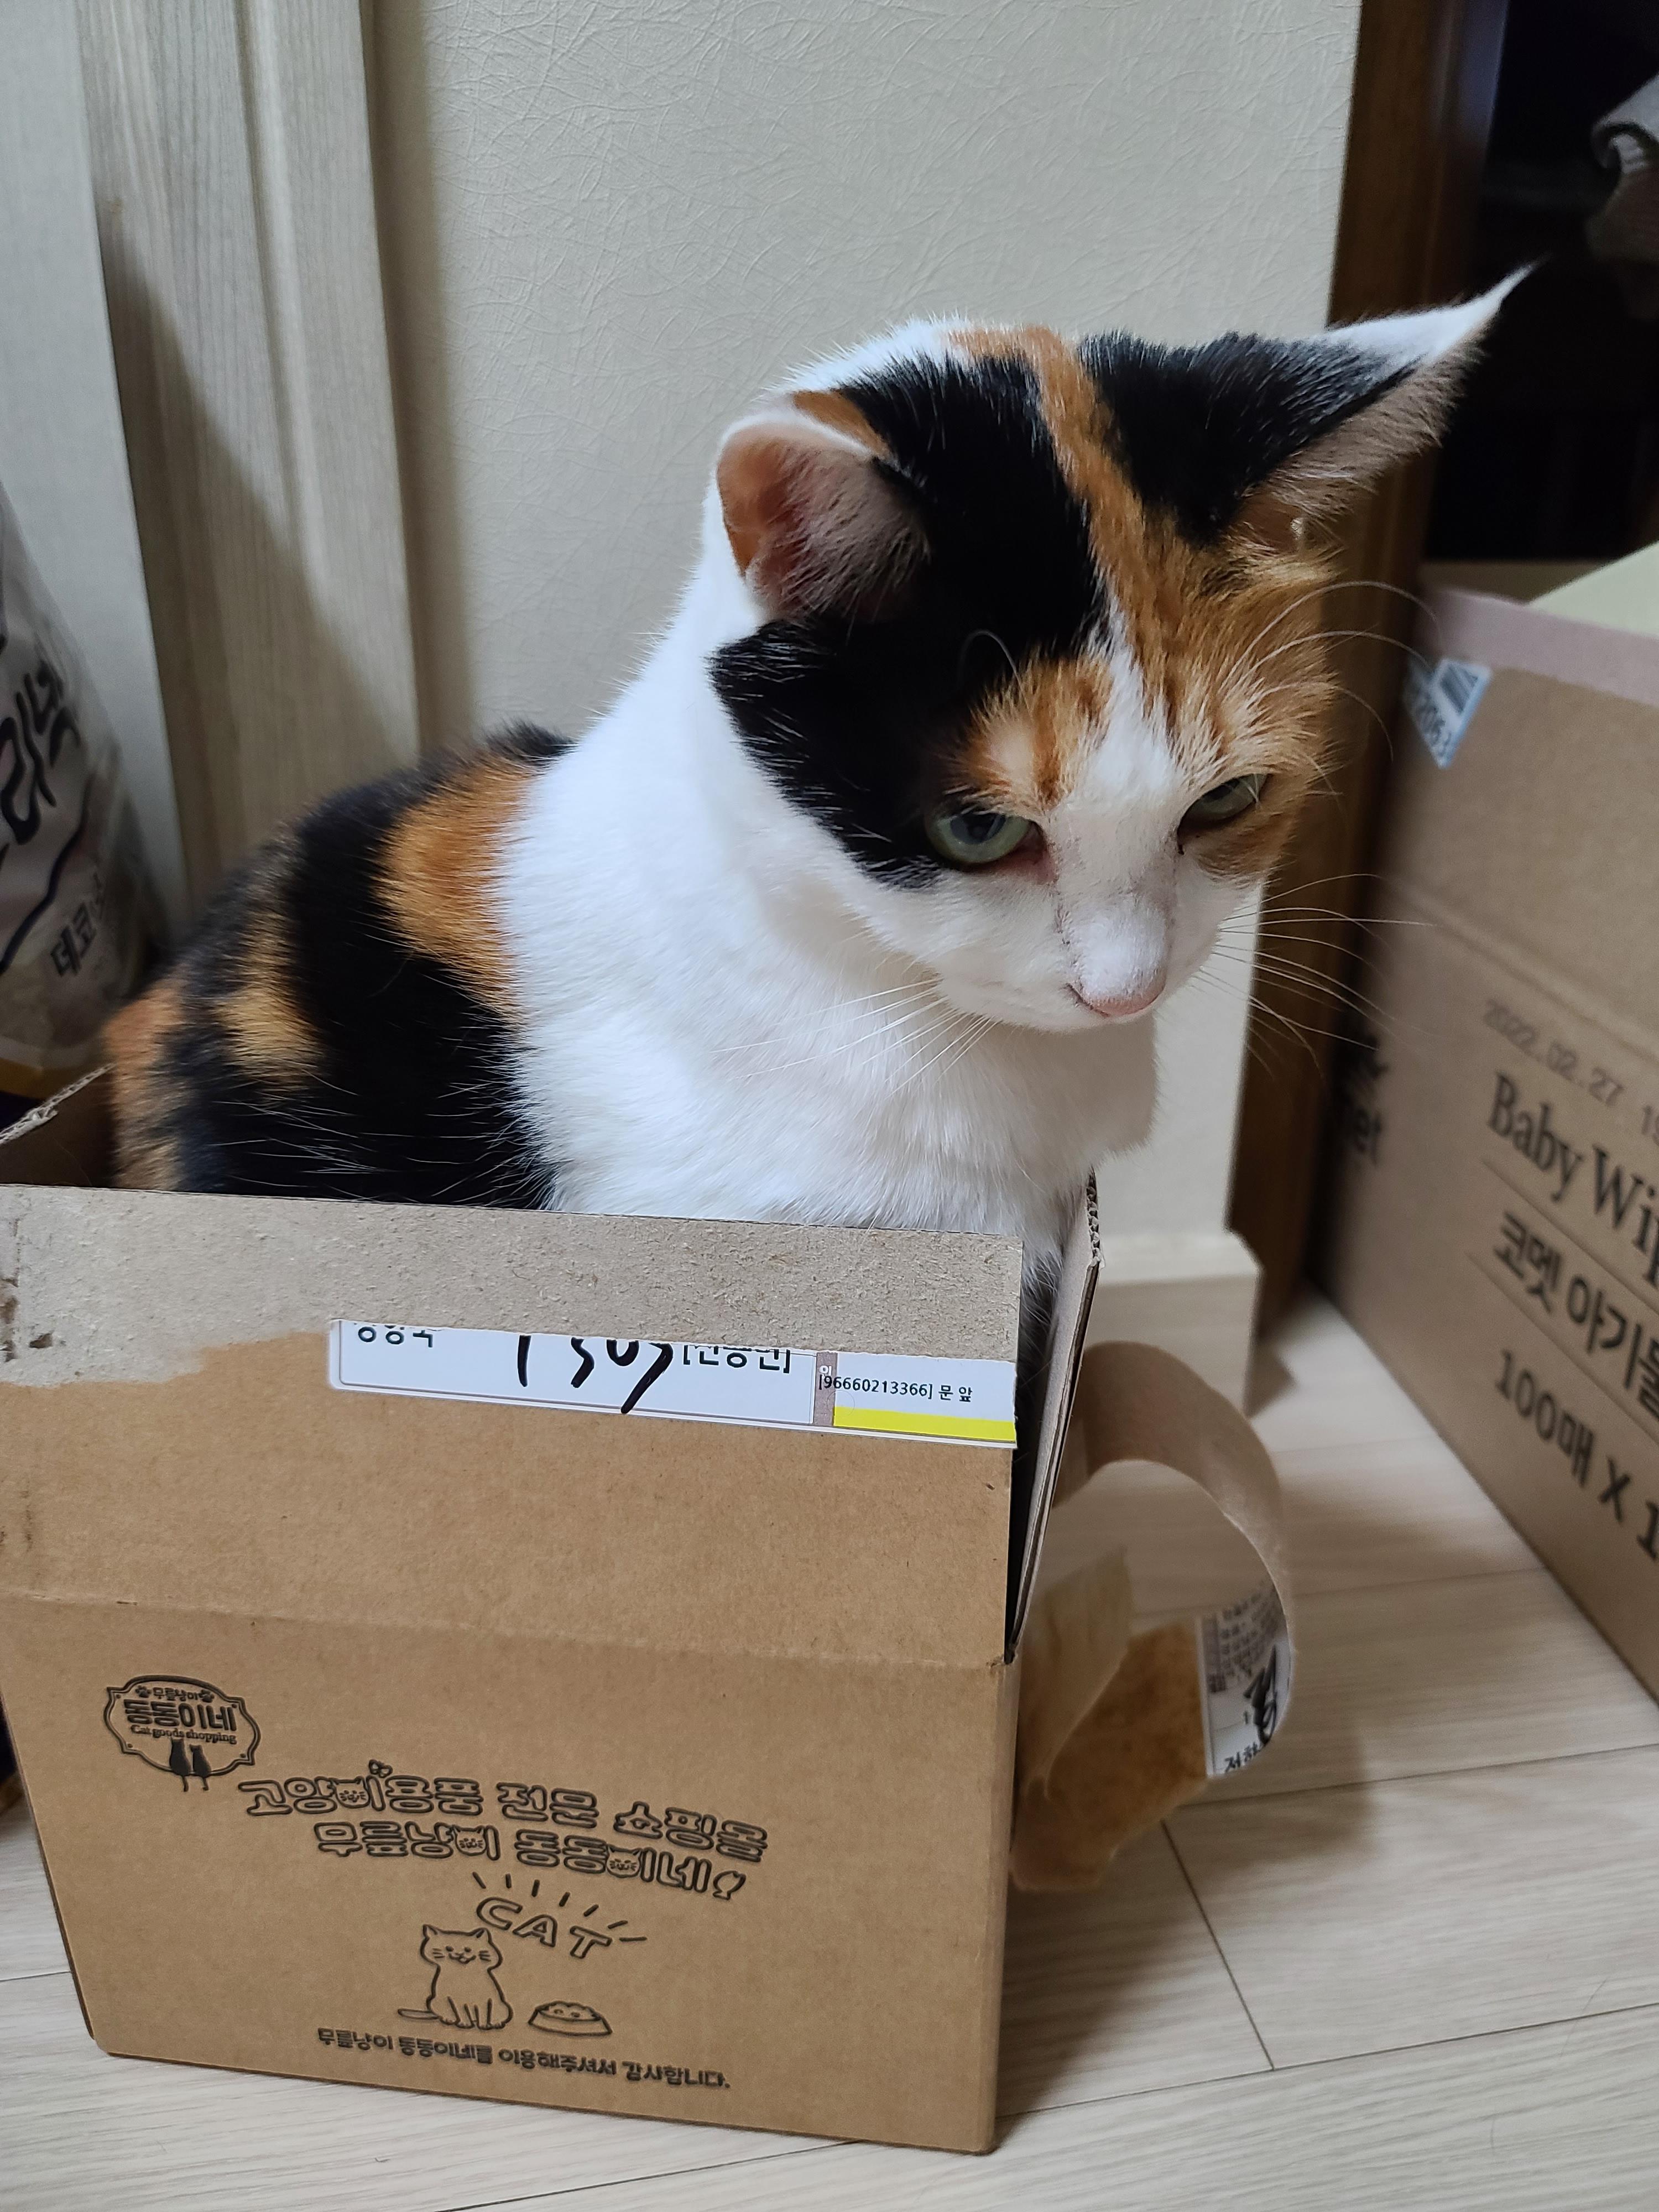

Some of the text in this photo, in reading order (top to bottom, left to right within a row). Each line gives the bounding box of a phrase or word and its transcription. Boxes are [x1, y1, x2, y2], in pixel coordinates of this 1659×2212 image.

[1488, 1069, 1583, 1202] Baby
[938, 1384, 953, 1400] 문
[958, 1386, 973, 1402] 앞
[1495, 1348, 1594, 1487] 100매
[123, 1699, 237, 1731] 동동이네
[131, 1724, 237, 1745] Cat goods shopping
[496, 1782, 599, 1829] 전문
[613, 1801, 769, 1863] 쇼핑몰
[476, 1896, 613, 1959] CAT
[317, 2027, 731, 2089] 무릎냥이 동동이네를 이용해주셔서 감사합니다.
